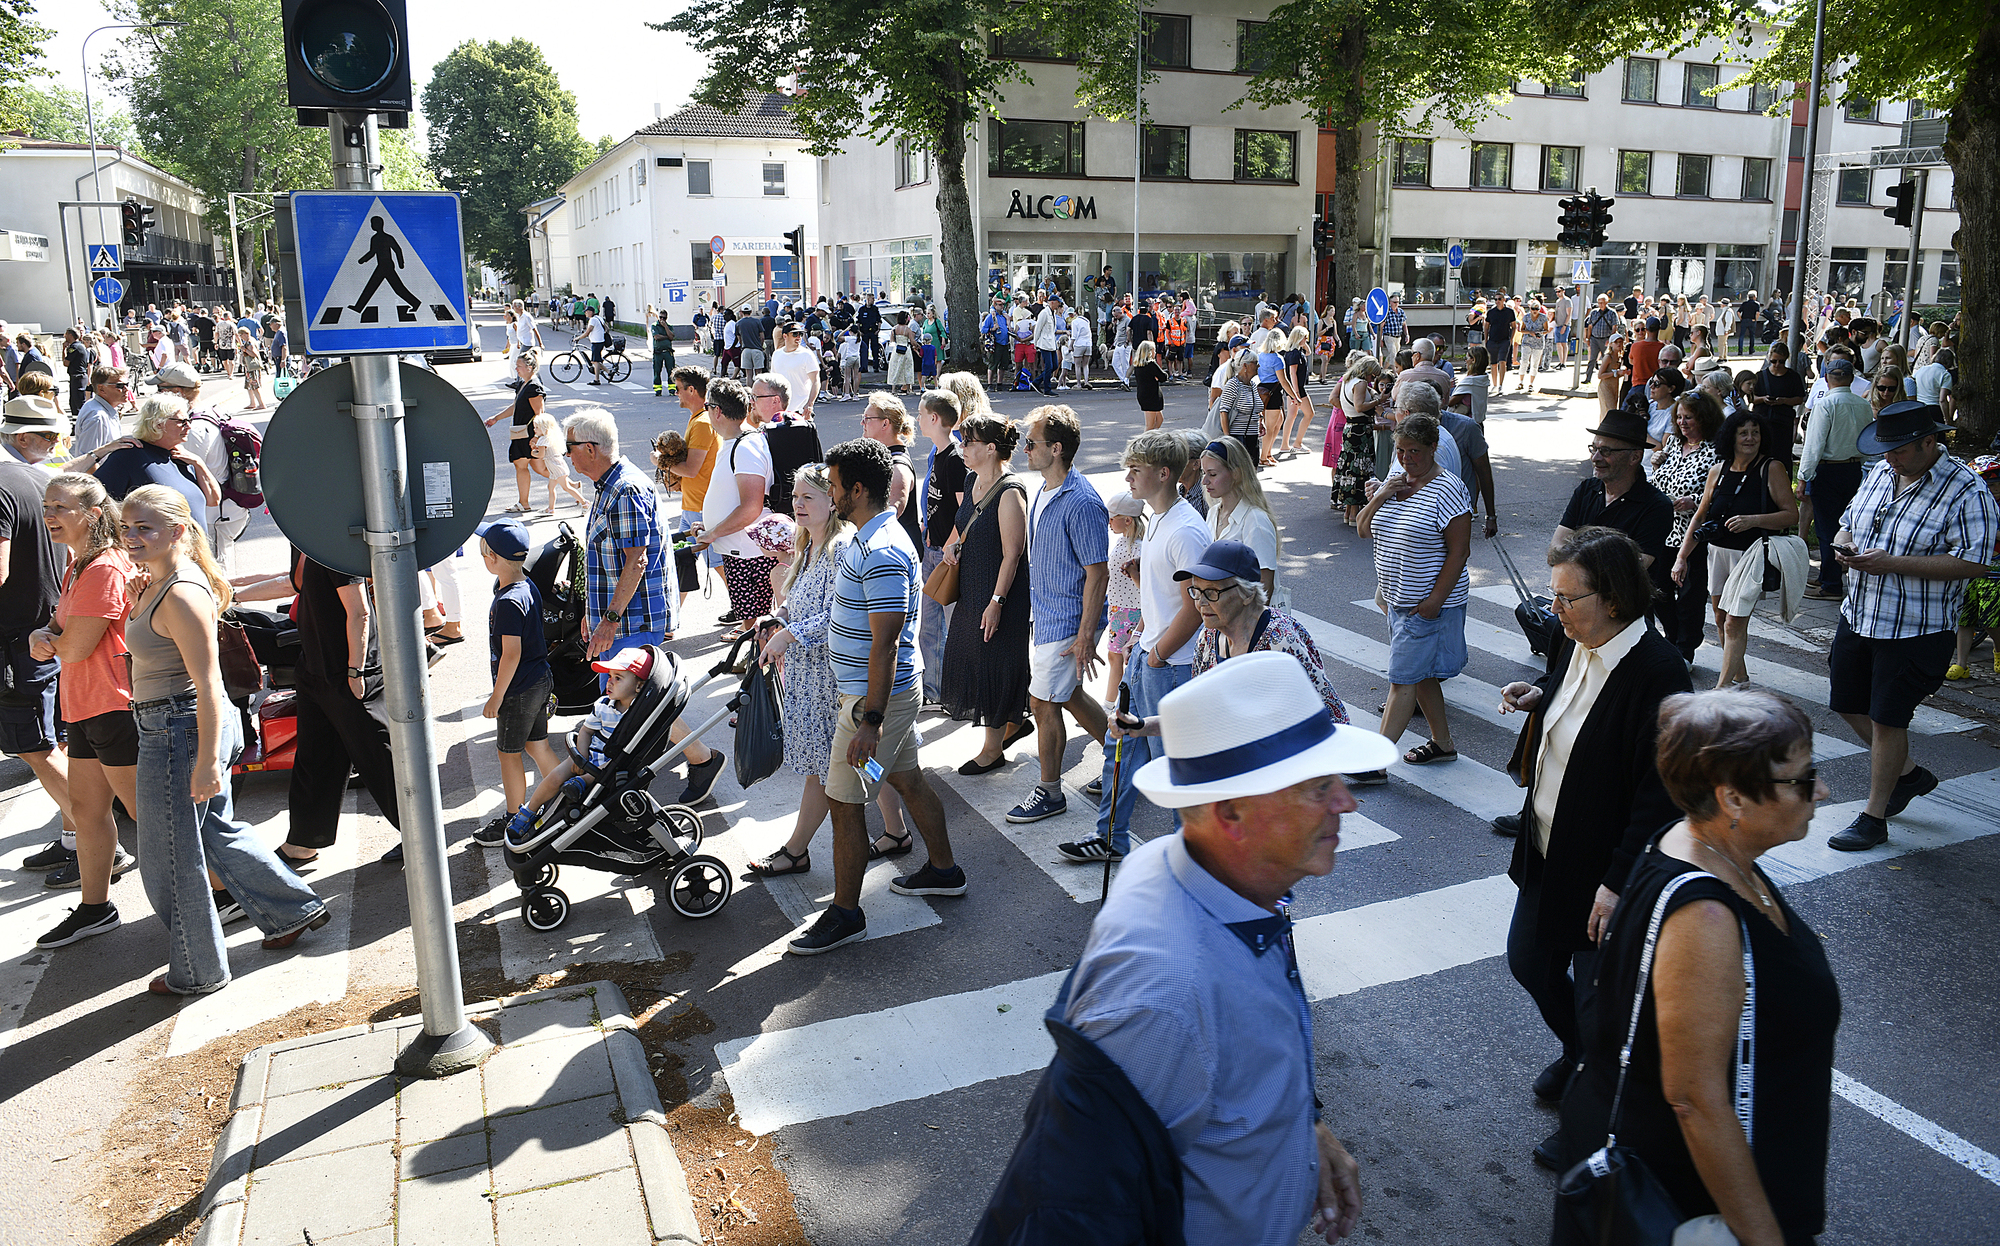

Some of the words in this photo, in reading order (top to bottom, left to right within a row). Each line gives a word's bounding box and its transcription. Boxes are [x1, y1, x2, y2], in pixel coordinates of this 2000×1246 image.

[1006, 189, 1097, 219] ÅLCOM
[732, 242, 787, 251] MARIEHAM
[672, 290, 680, 302] P
